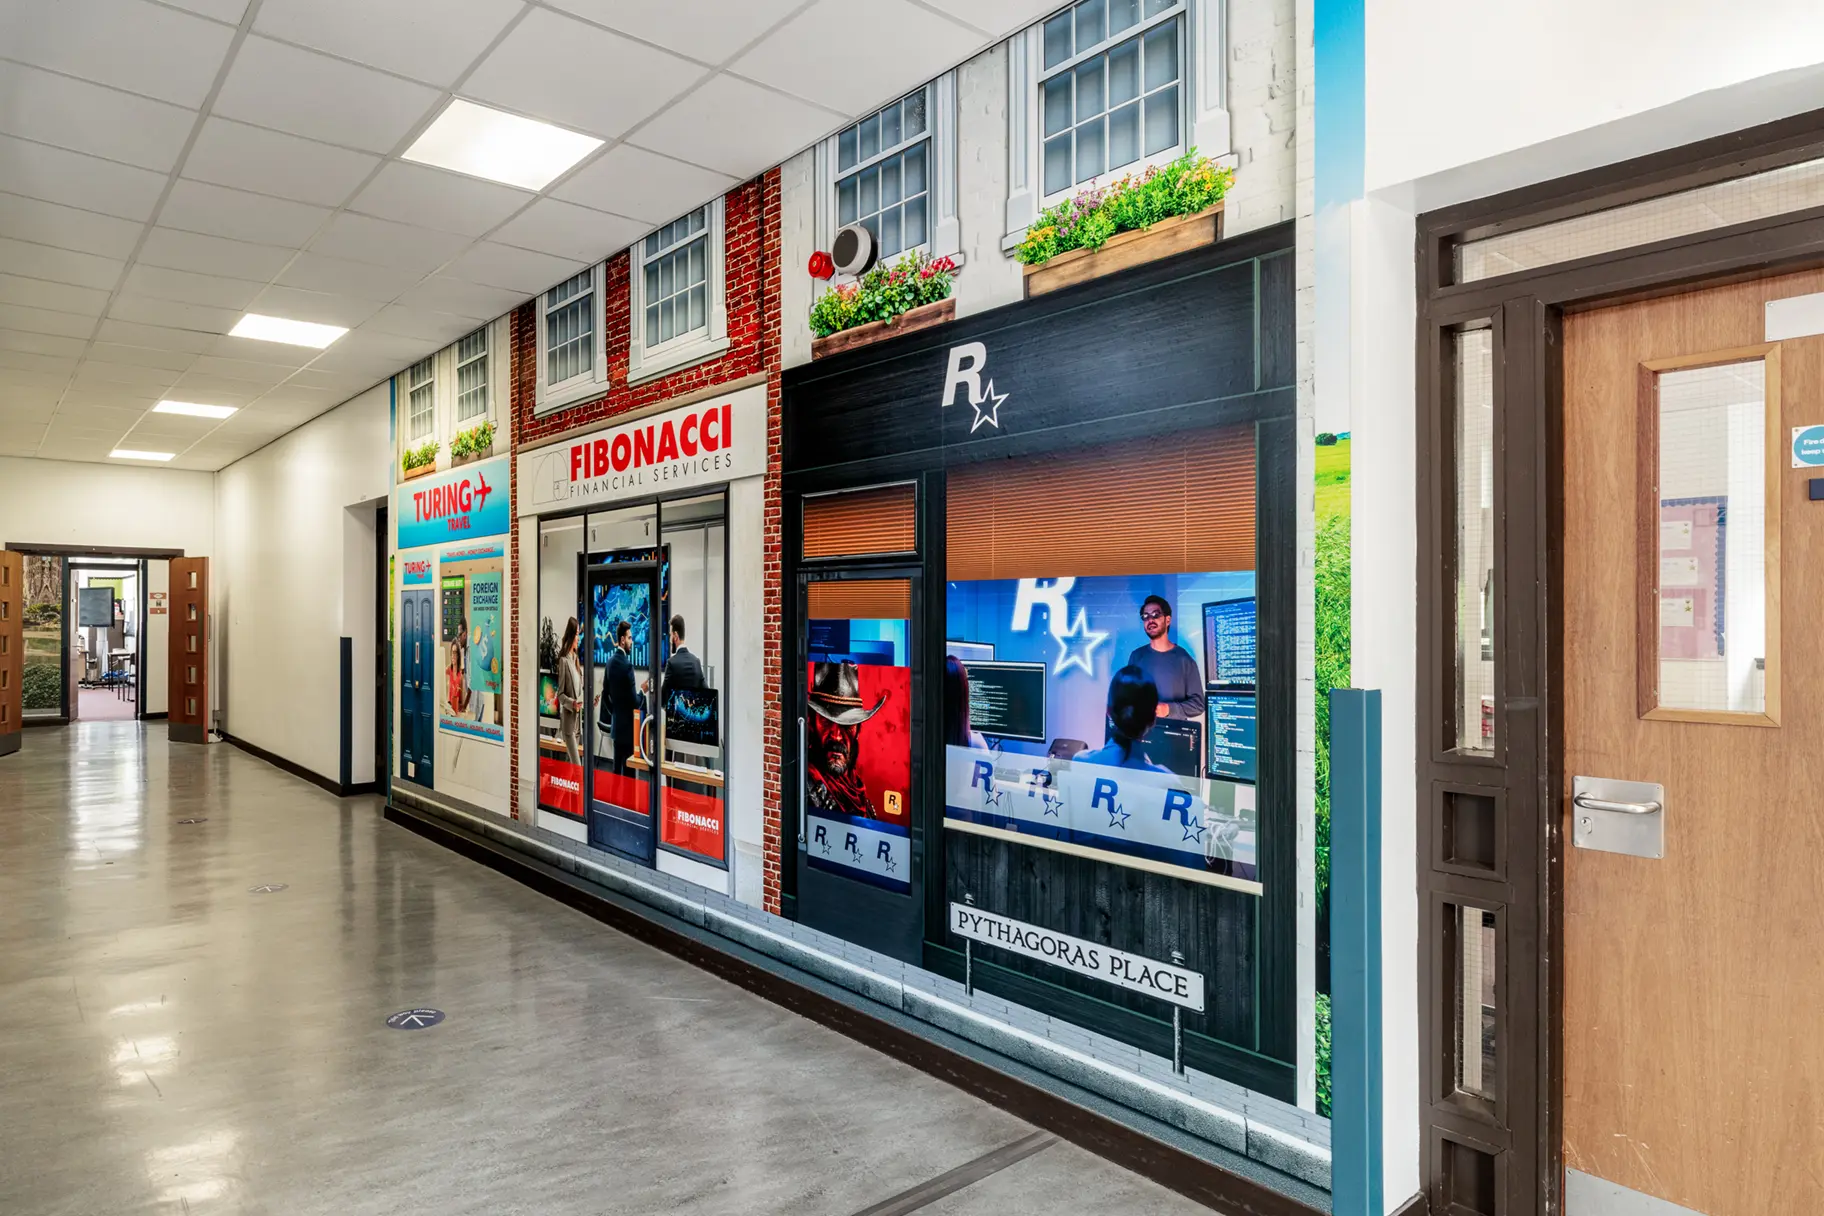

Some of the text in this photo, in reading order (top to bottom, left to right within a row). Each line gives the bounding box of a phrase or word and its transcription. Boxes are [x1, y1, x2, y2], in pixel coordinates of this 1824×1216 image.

[942, 342, 987, 407] R
[570, 403, 732, 482] FIBONACCI
[570, 453, 732, 498] FINANCIAL SERVICES
[413, 479, 472, 522] TURING
[447, 515, 471, 532] TRAVEL
[404, 560, 425, 575] TURING
[473, 582, 498, 594] FOREIGN
[473, 594, 498, 605] EXCHANGE
[551, 775, 579, 791] FIBONACCI
[677, 810, 719, 830] FIBONACCI
[958, 910, 1189, 998] PYTHAGORAS PLACE
